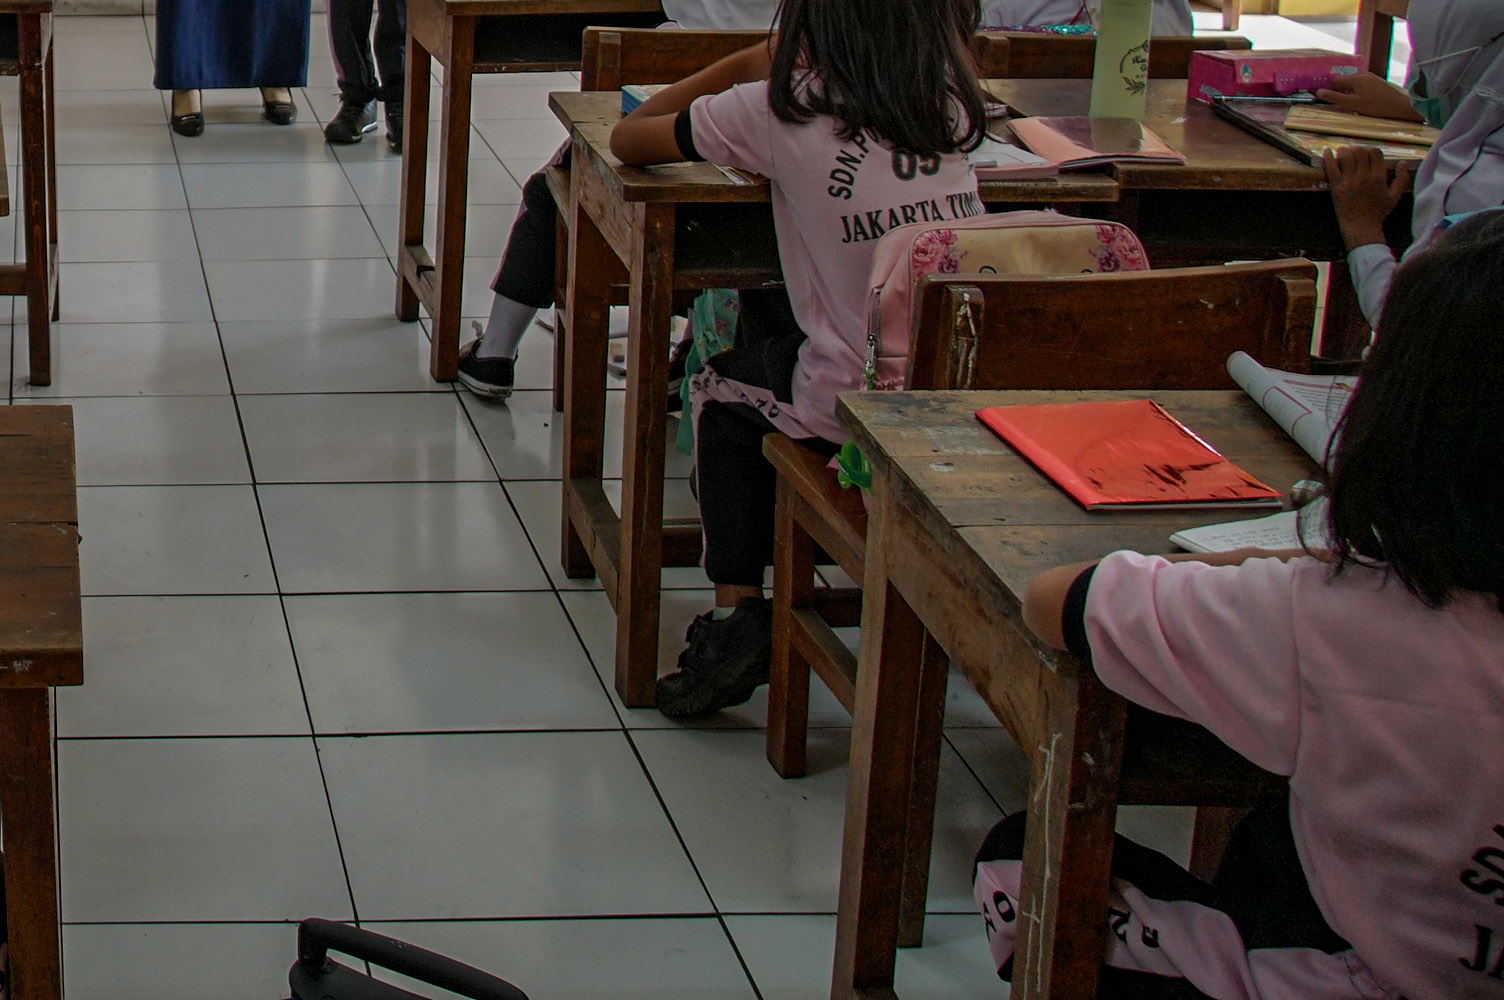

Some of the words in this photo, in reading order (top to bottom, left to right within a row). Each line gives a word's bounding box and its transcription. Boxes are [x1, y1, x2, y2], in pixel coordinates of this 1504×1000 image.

[827, 126, 880, 200] SDN.P
[840, 199, 944, 244] JAKARTA
[946, 191, 980, 219] TIM
